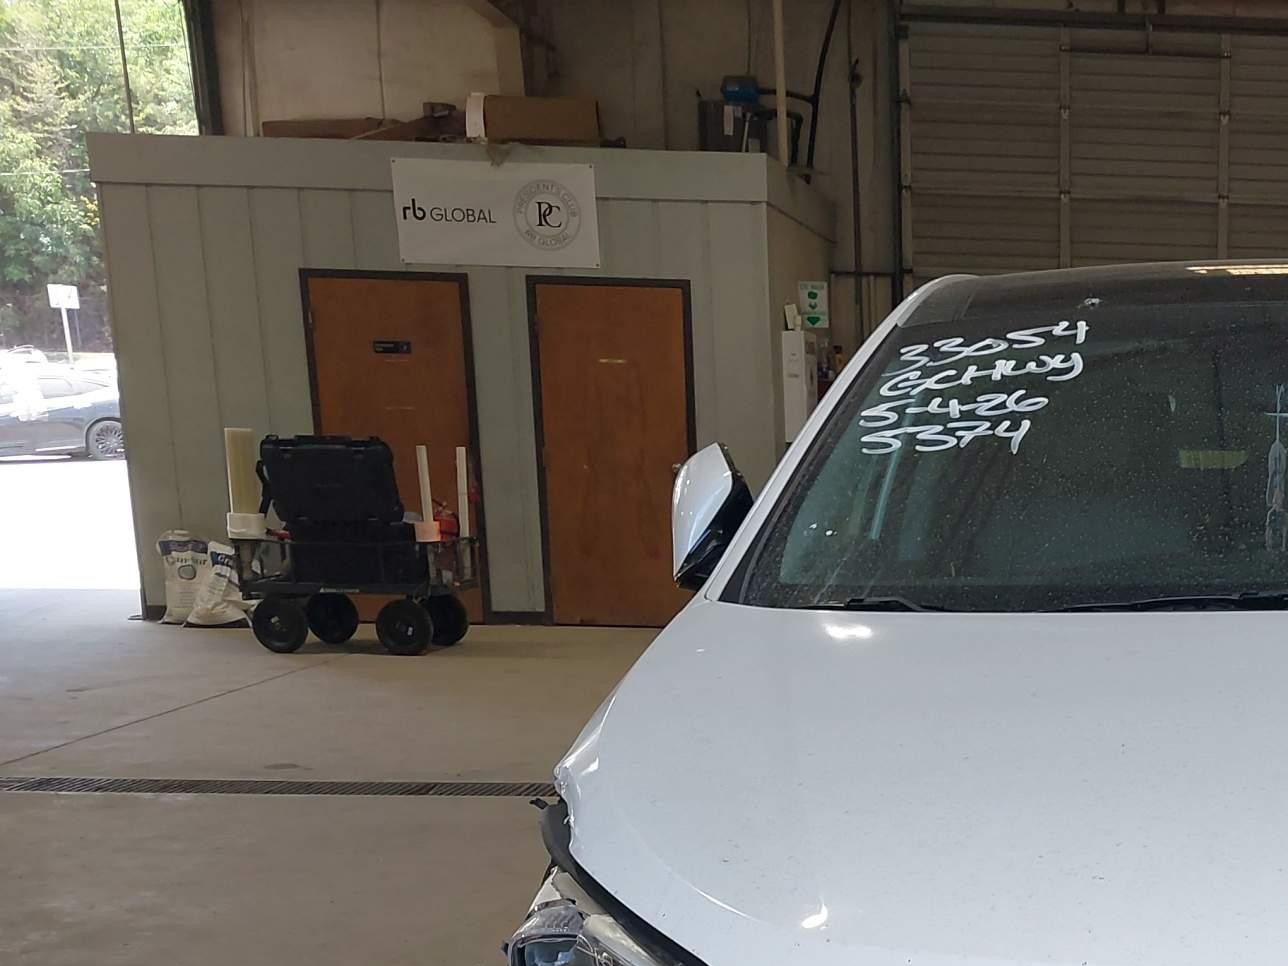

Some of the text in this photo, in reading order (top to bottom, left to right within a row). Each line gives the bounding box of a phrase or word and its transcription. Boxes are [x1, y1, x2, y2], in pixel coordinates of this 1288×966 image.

[402, 198, 497, 224] rb GLOBAL
[882, 320, 1090, 377] 33054
[860, 419, 1032, 455] 5374
